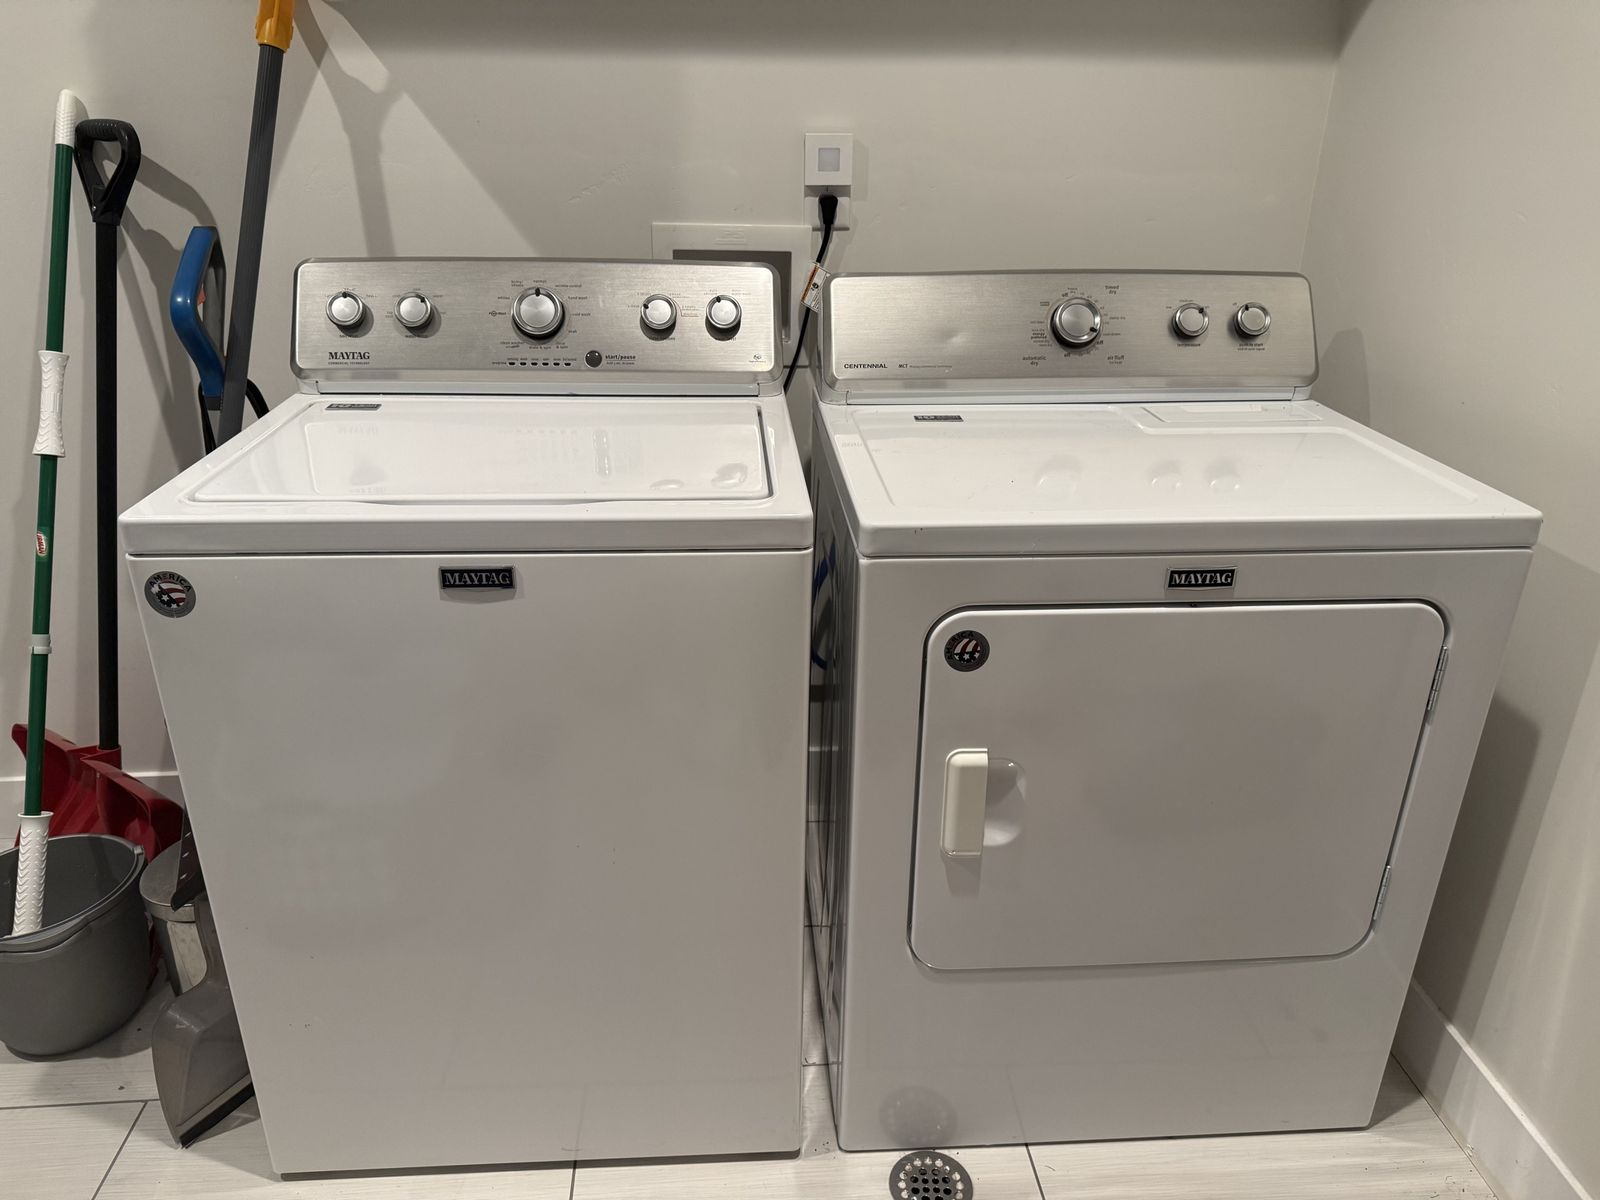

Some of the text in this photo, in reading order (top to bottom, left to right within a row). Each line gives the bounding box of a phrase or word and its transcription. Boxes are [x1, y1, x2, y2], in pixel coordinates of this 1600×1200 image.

[328, 352, 370, 360] MAYTAG
[150, 574, 192, 592] AMERICA
[445, 573, 510, 584] MAYTAG
[1171, 573, 1232, 584] MAYTAG
